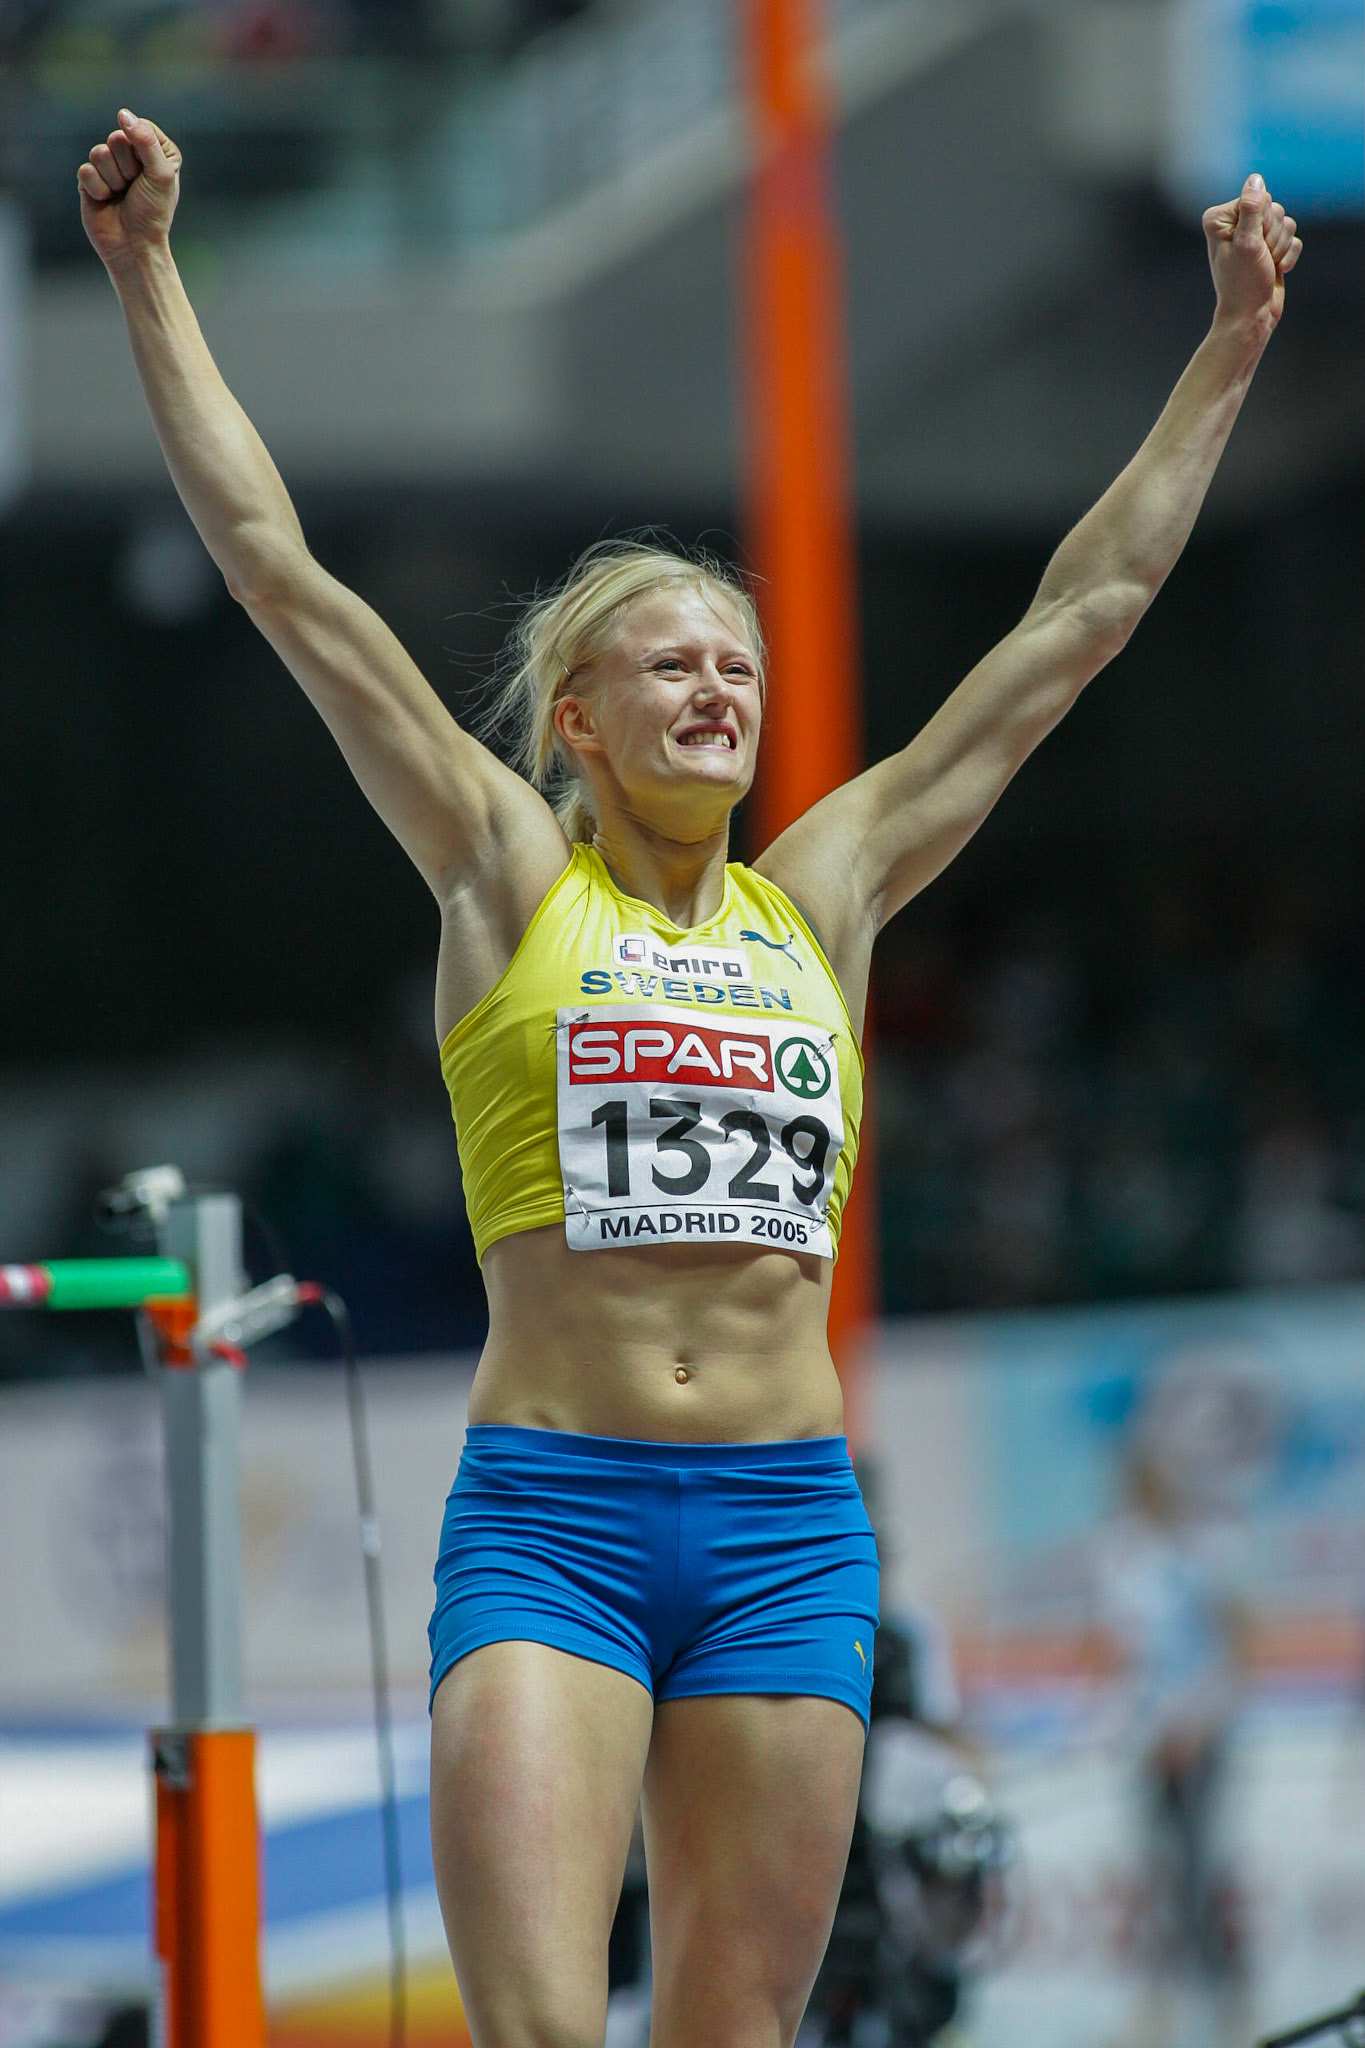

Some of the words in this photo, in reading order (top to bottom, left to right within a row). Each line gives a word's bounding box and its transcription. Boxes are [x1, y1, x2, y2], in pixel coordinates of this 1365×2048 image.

[652, 951, 742, 978] eniro
[580, 970, 793, 1011] SWEDEN
[570, 1029, 769, 1083] SPAR
[591, 1098, 831, 1206] 1329
[600, 1213, 740, 1240] MADRID
[750, 1214, 808, 1245] 2005
